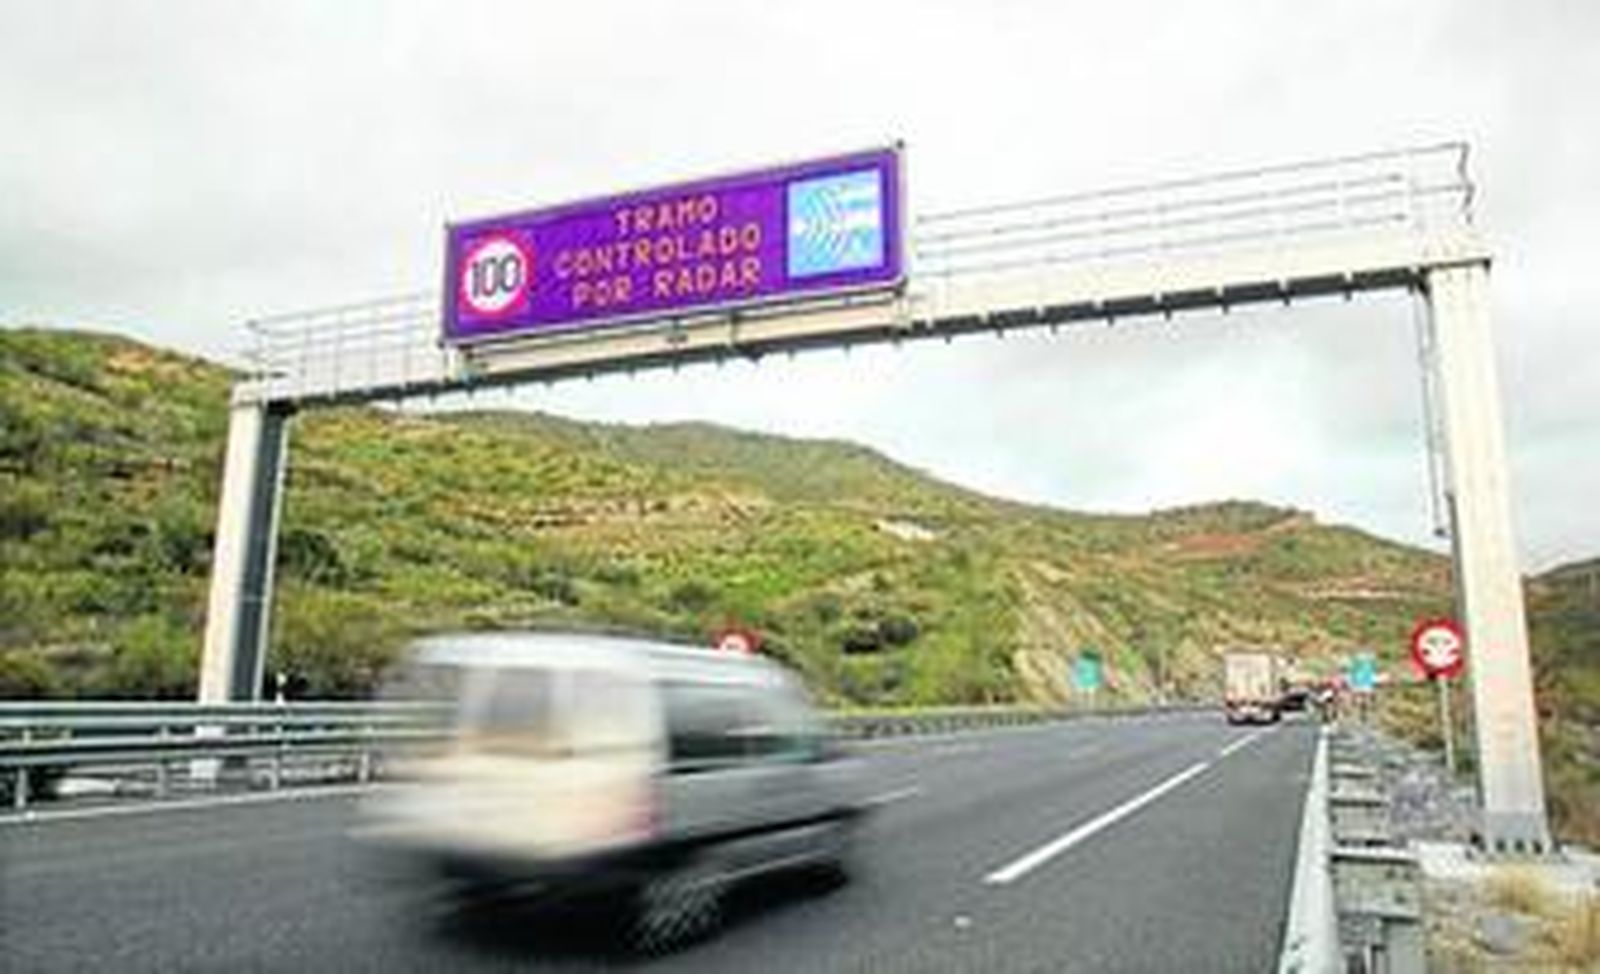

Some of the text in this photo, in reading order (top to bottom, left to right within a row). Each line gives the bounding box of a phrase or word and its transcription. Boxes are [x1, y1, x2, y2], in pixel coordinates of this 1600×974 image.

[615, 197, 717, 234] TRAMO
[555, 224, 761, 278] CONTROLADO
[470, 254, 521, 298] 100
[573, 259, 760, 308] POR RADAR
